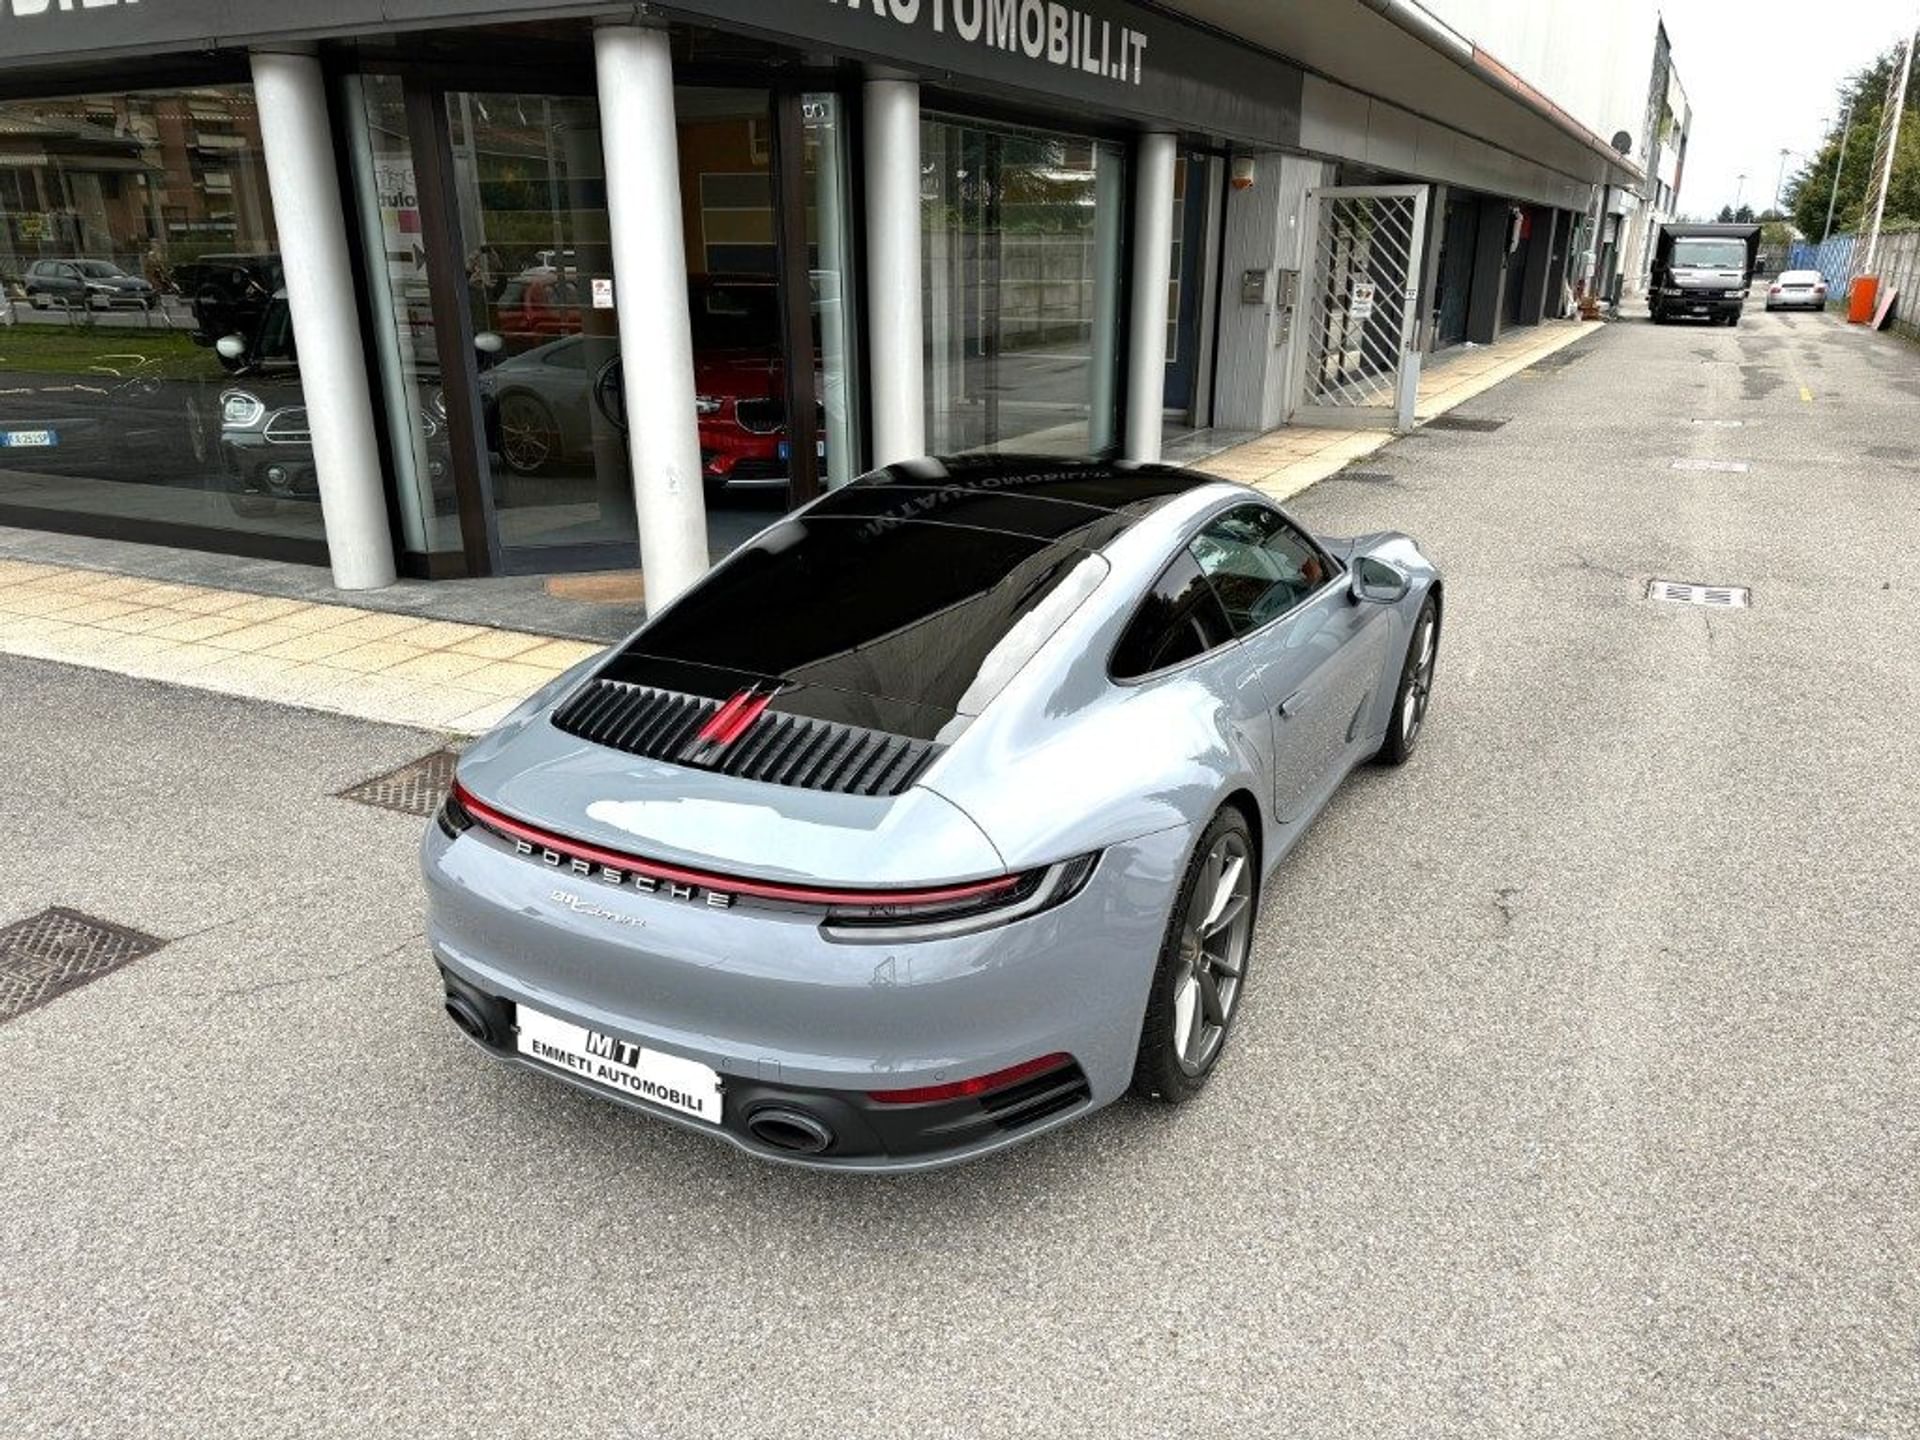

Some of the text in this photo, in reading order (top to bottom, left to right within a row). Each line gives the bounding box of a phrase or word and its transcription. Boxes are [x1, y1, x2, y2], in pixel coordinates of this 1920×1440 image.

[516, 840, 730, 908] PORSCHE
[532, 1039, 703, 1112] EMMETI AUTOMOBILI
[587, 1031, 641, 1068] MT
